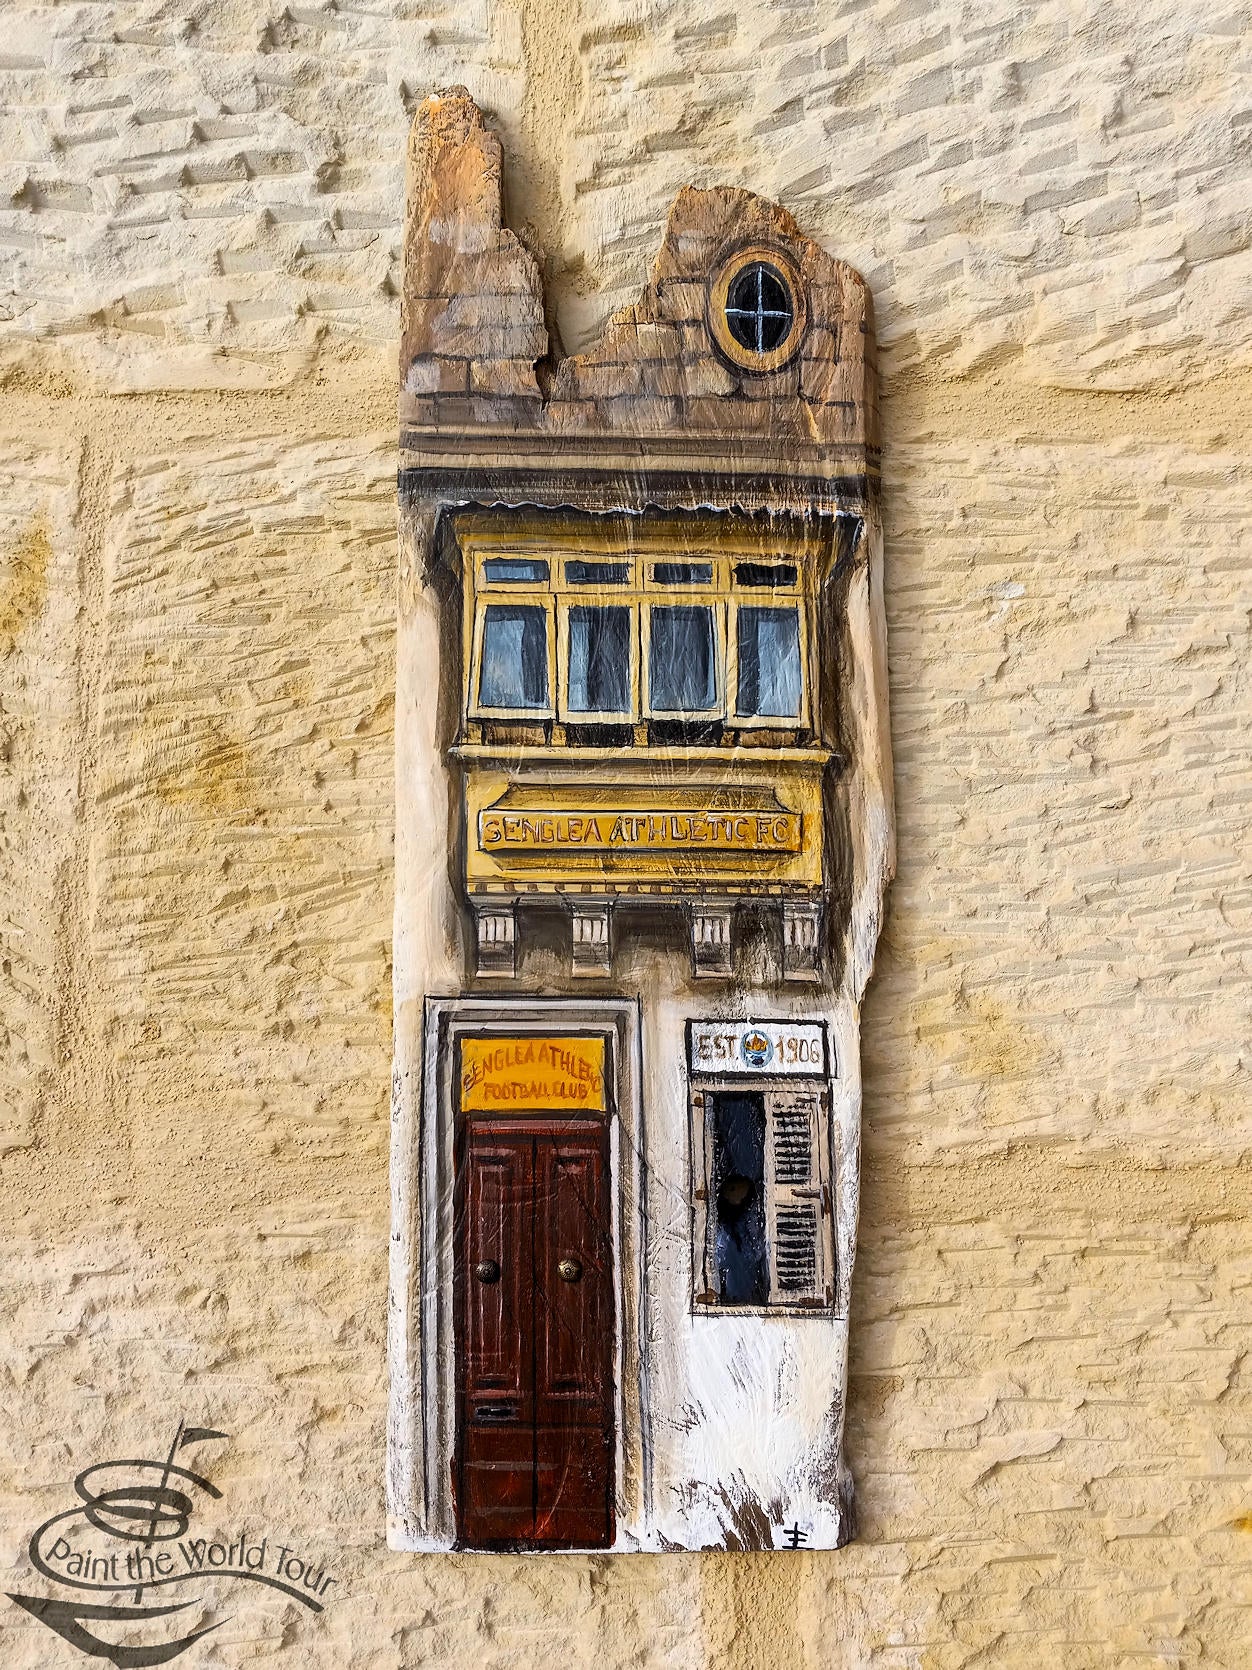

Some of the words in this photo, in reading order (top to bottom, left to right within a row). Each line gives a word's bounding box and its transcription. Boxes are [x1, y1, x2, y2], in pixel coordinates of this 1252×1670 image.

[485, 816, 603, 844] SENGLEA
[609, 815, 749, 842] ATHLETIC
[755, 817, 790, 843] FC
[774, 1035, 820, 1064] 1906
[552, 1081, 588, 1100] CLUB
